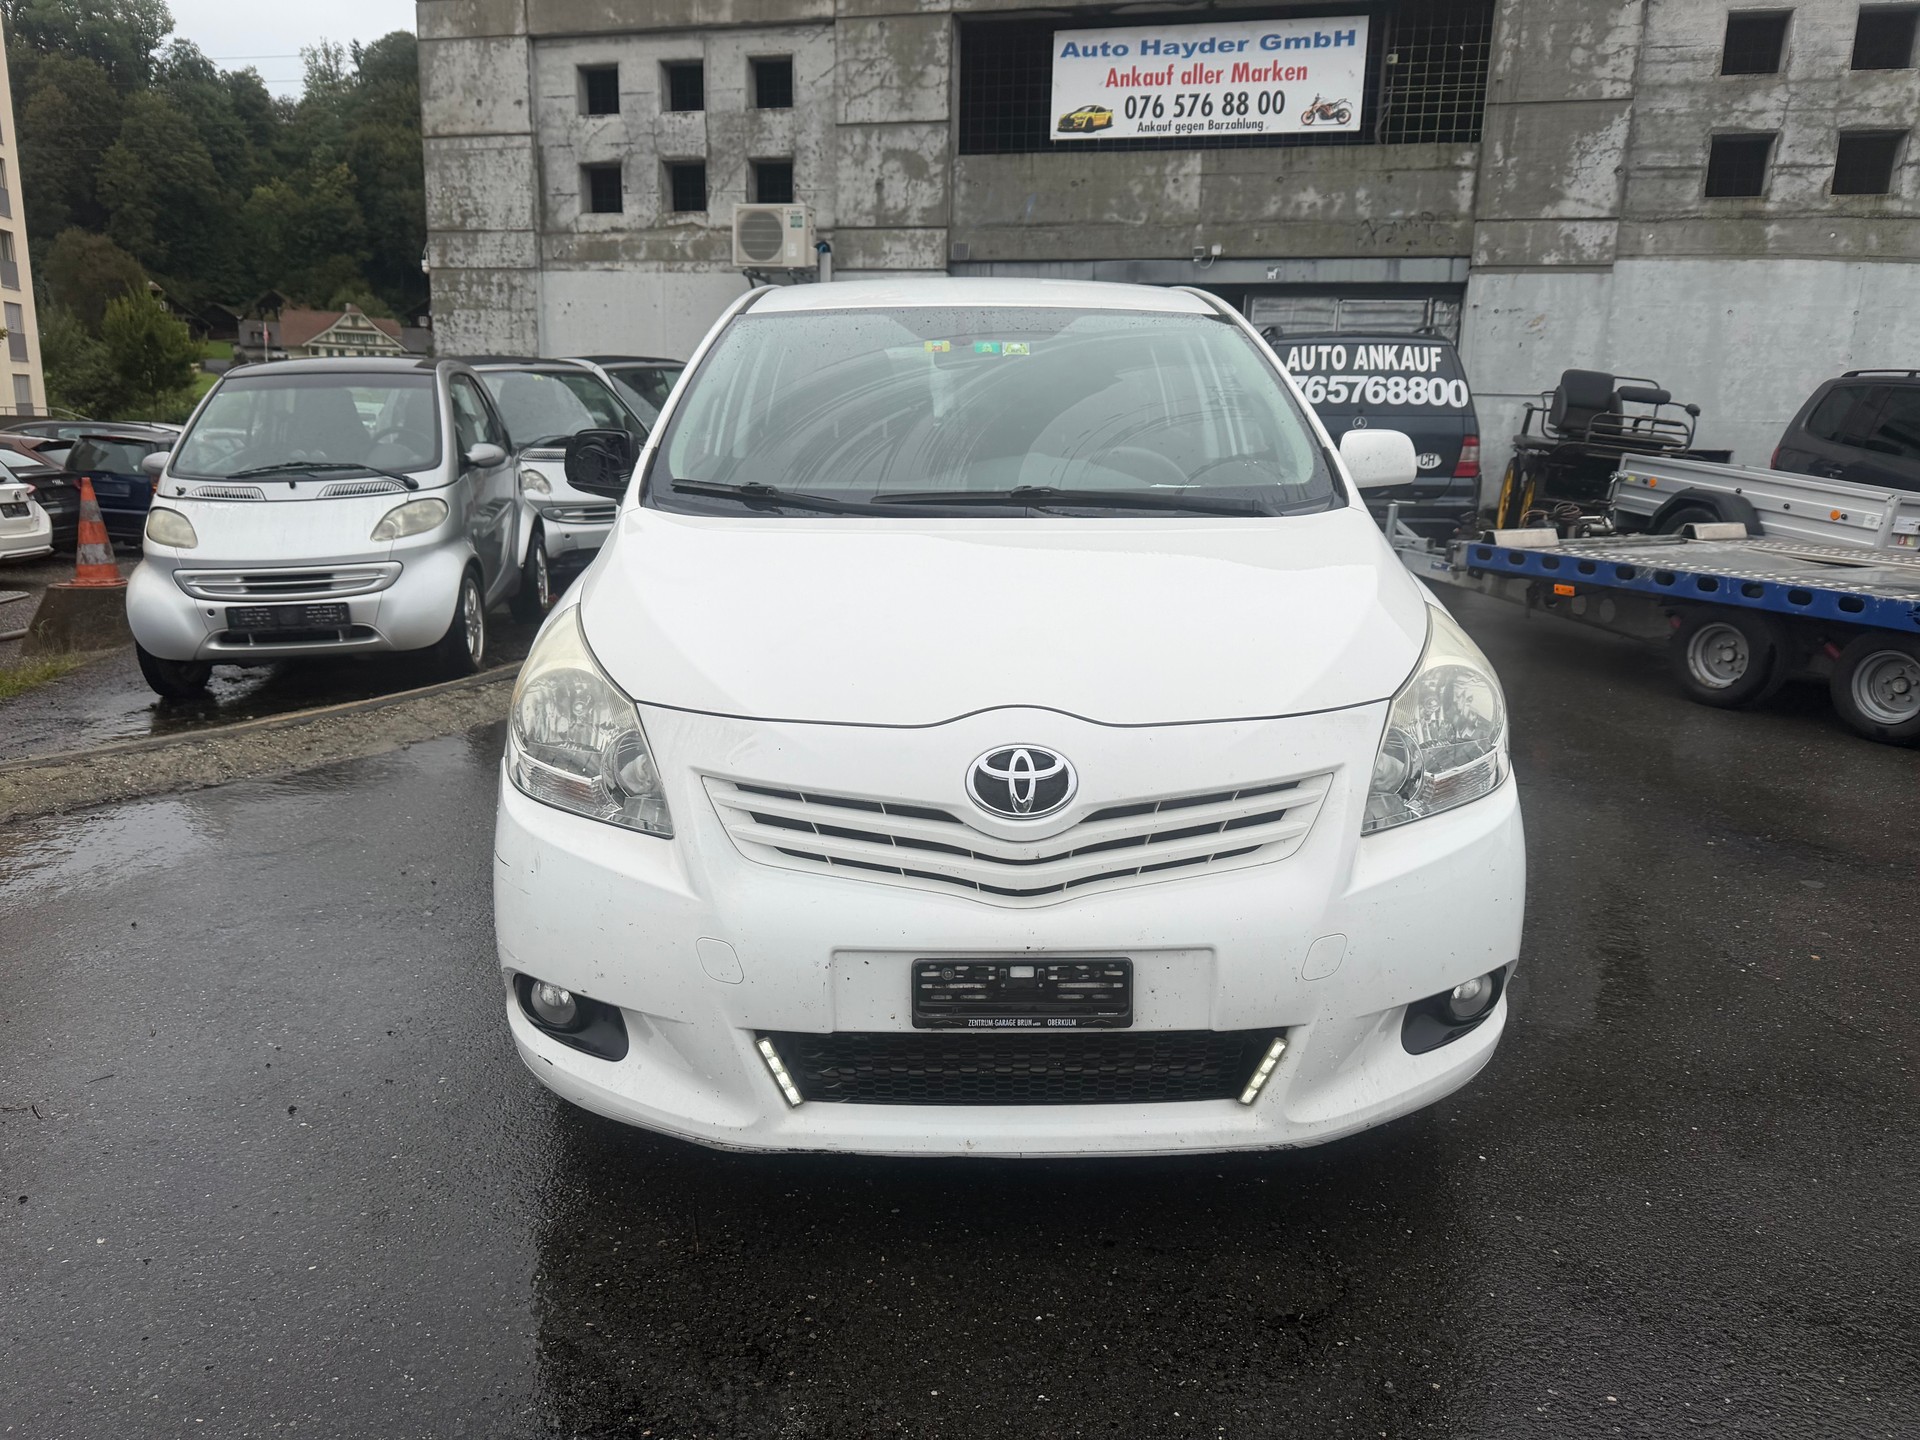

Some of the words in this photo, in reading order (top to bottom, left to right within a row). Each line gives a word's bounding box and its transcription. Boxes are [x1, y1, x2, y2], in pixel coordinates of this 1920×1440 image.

[1060, 40, 1129, 58] Auto
[1140, 37, 1249, 59] Hayder
[1259, 29, 1356, 51] GmbH
[1105, 64, 1174, 88] Ankauf
[1181, 62, 1224, 85] aller
[1231, 59, 1308, 83] Marken
[1124, 94, 1165, 119] 076
[1173, 92, 1213, 118] 576
[1222, 91, 1249, 117] 88
[1257, 90, 1285, 115] 00
[1137, 120, 1172, 133] Ankauf
[1175, 122, 1204, 134] gegen
[1208, 118, 1264, 132] Barzahlung
[1286, 345, 1347, 372] AUTO
[1353, 344, 1442, 373] ANKAUF
[1419, 454, 1436, 467] CH
[1017, 1019, 1032, 1027] BRUN
[1047, 1019, 1077, 1027] OBERKULM
